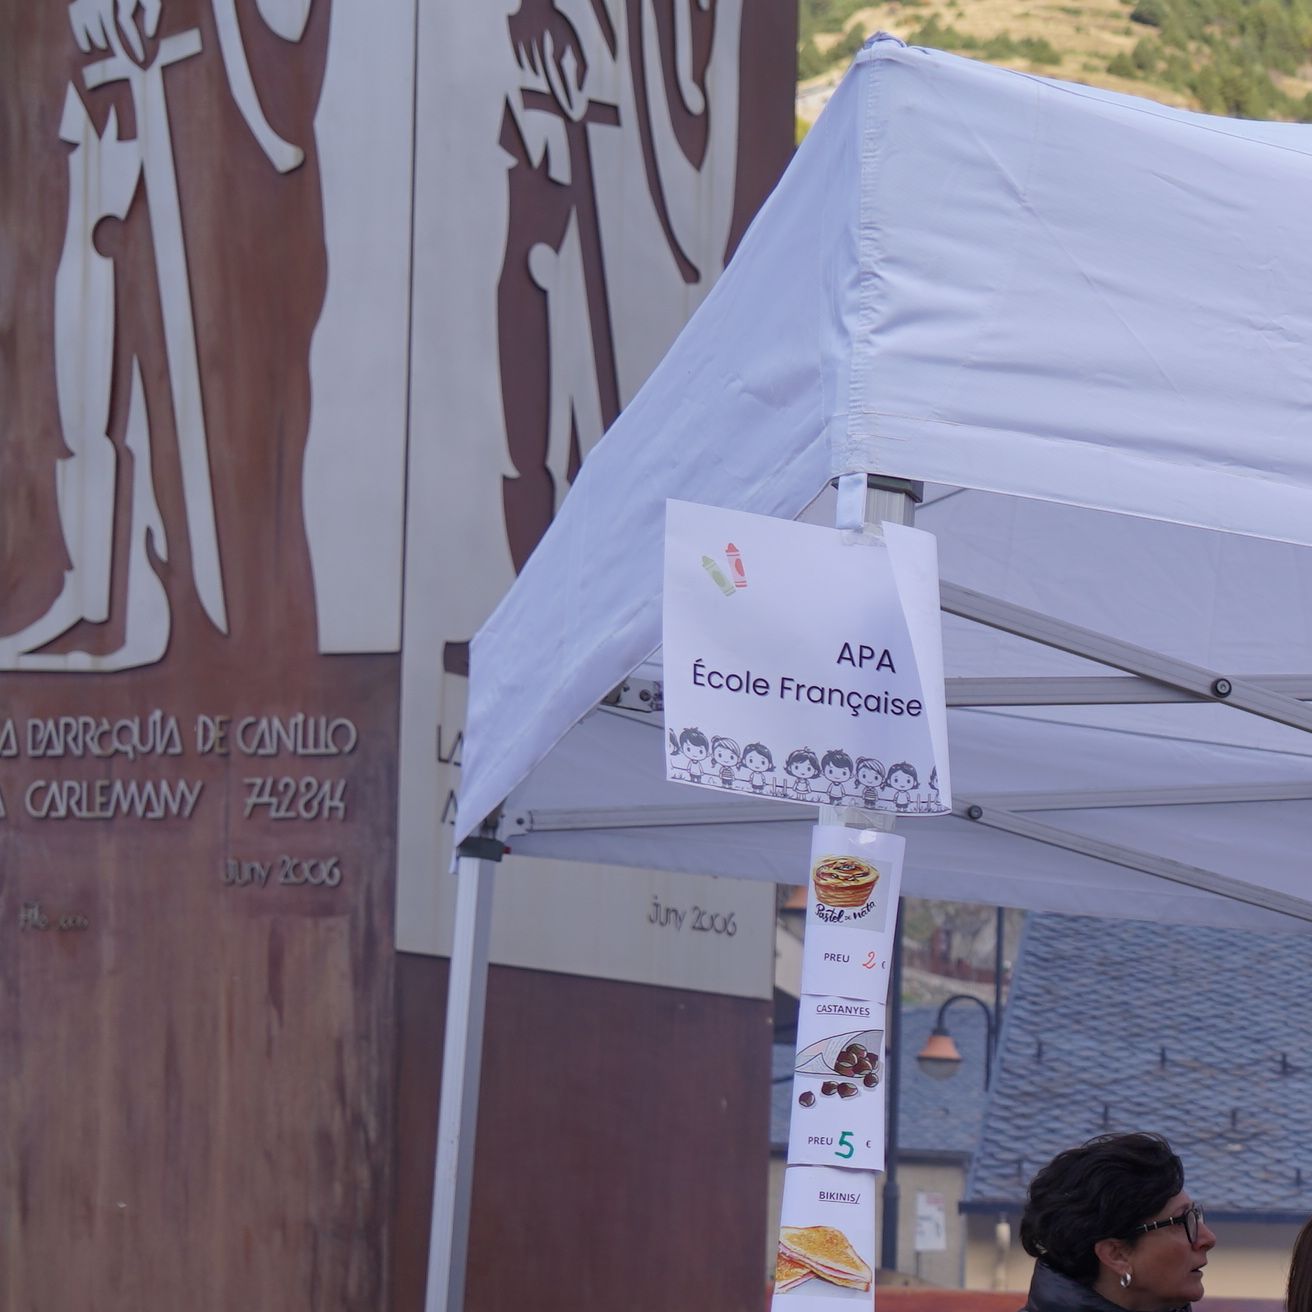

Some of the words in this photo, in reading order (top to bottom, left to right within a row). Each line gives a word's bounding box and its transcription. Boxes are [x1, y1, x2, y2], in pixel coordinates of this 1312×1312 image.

[836, 642, 896, 674] APA
[692, 658, 770, 697] École
[779, 676, 922, 717] Française
[197, 715, 231, 755] DE
[24, 778, 204, 820] CARLEMANY
[277, 854, 342, 887] 2006
[692, 904, 738, 938] 2006
[823, 952, 850, 963] PREU
[862, 951, 876, 969] 2
[816, 1003, 871, 1016] CASTANYES
[807, 1136, 833, 1147] PREU
[834, 1131, 855, 1158] 5
[865, 1139, 872, 1149] €
